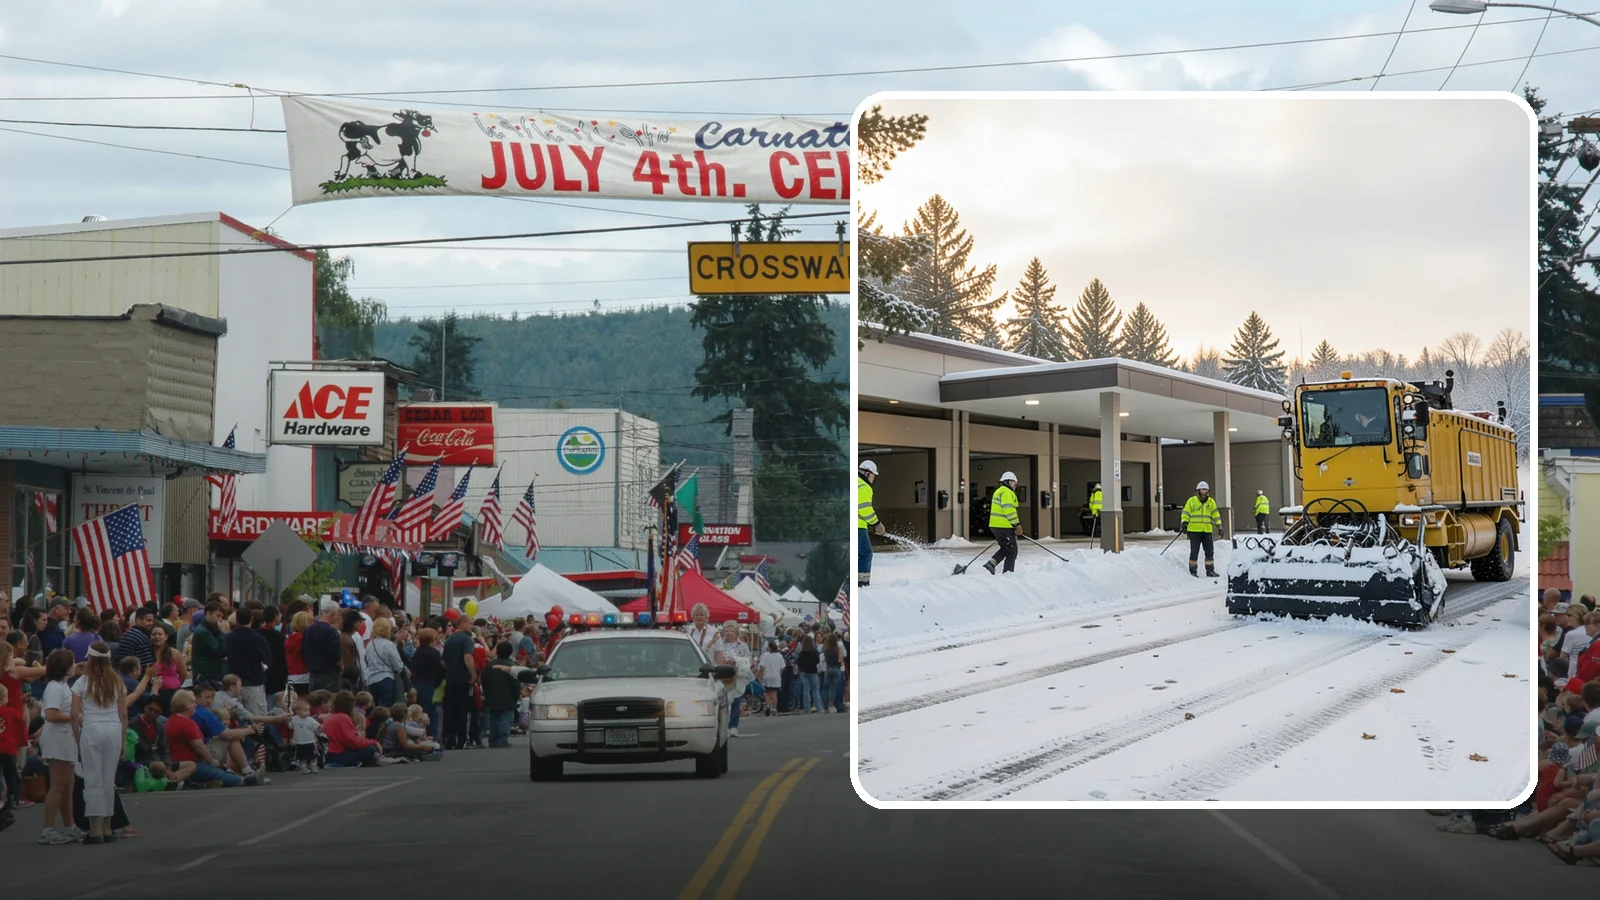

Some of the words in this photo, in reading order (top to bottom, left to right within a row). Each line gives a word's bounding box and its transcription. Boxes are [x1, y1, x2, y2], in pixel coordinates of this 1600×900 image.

[695, 121, 850, 150] Carnat
[481, 141, 605, 193] JULY
[632, 150, 747, 198] 4th.
[697, 254, 850, 280] CROSSWA
[282, 380, 374, 420] ACE
[405, 409, 452, 422] CEDAR
[283, 421, 371, 437] Hardware
[416, 428, 477, 447] Coca-Cola
[353, 467, 385, 481] Simpl
[96, 485, 124, 495] Vincent
[126, 486, 136, 494] de
[137, 486, 155, 496] Paul
[213, 515, 331, 535] HARDARE
[688, 526, 741, 535] CRNATION
[699, 534, 730, 543] GLASS
